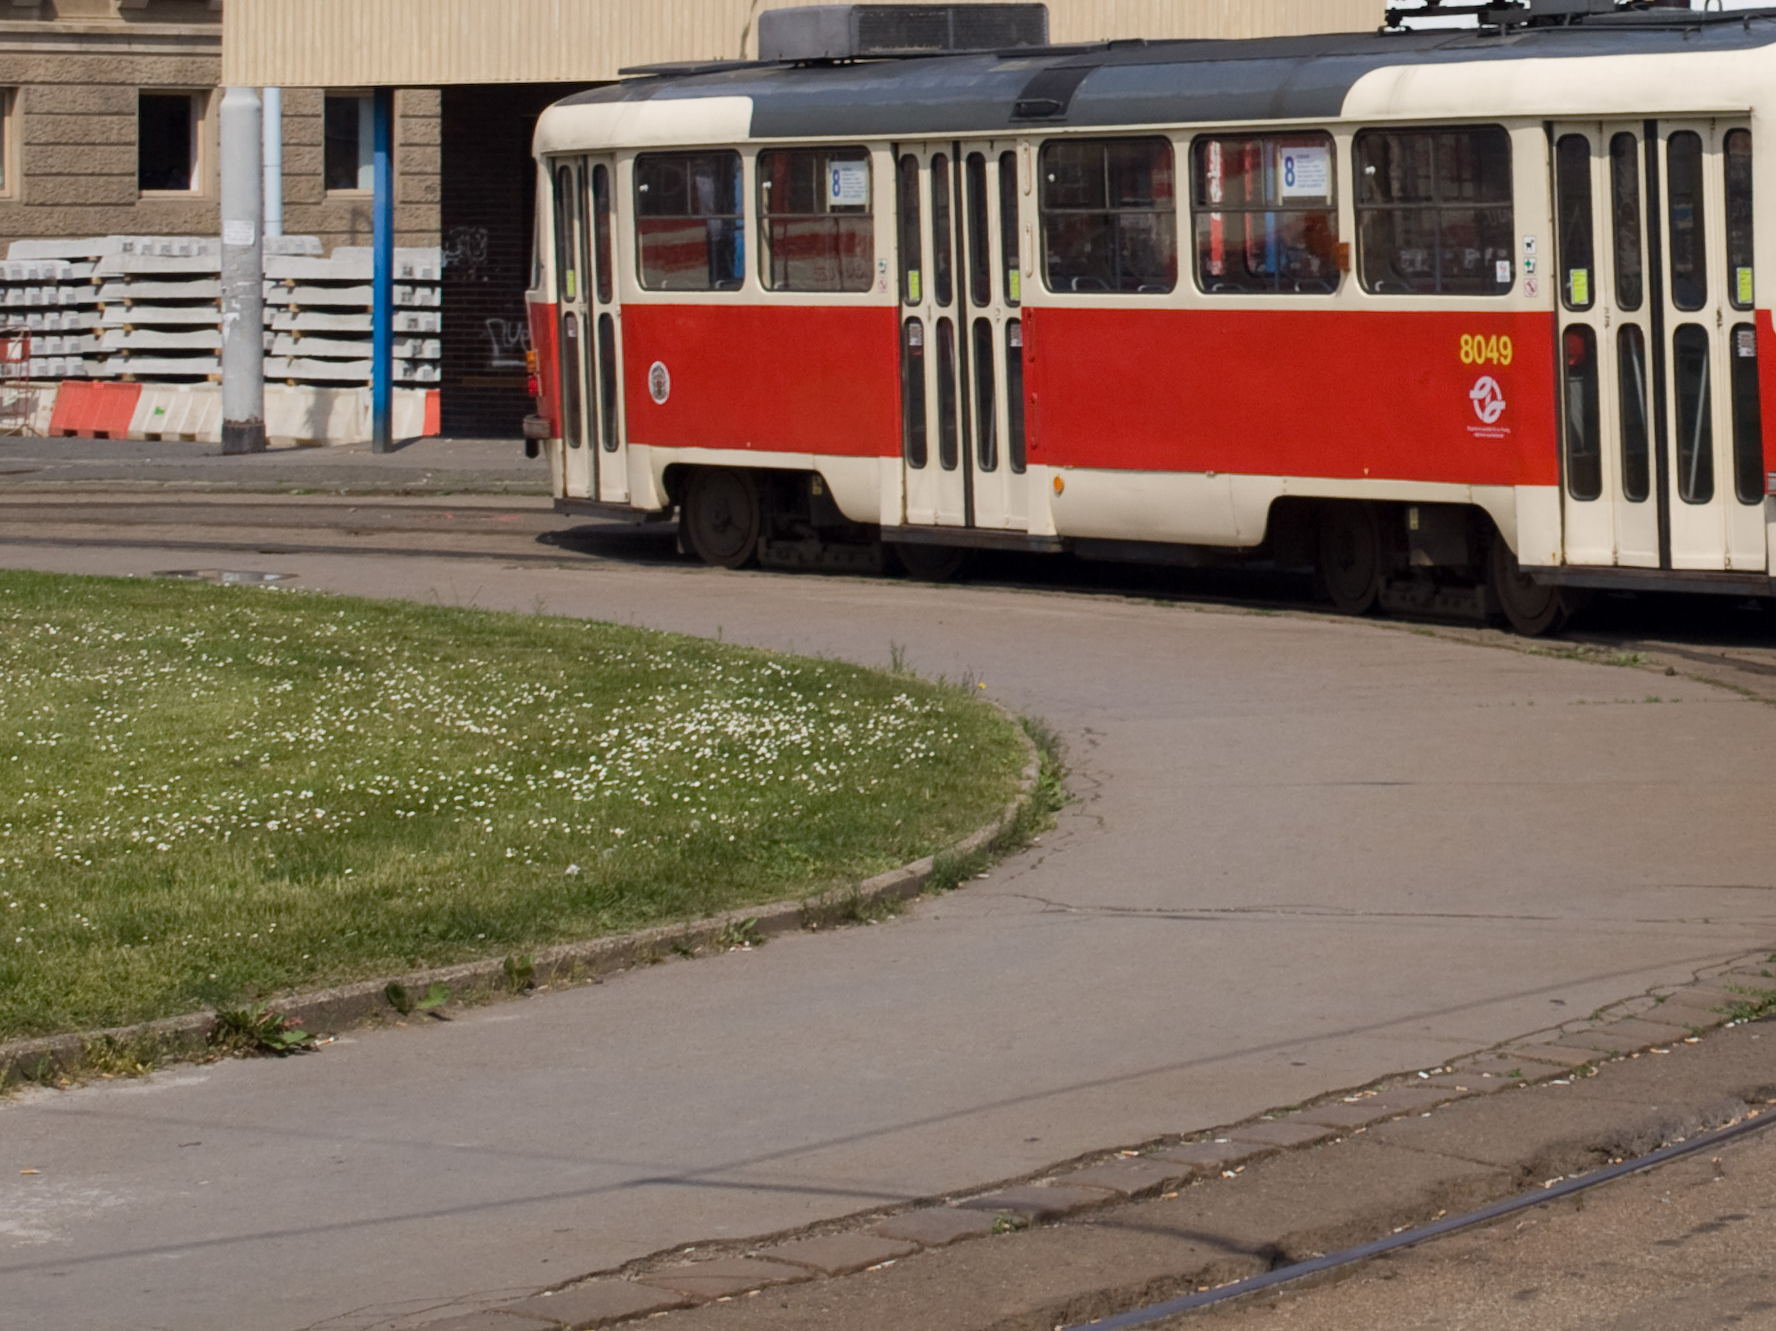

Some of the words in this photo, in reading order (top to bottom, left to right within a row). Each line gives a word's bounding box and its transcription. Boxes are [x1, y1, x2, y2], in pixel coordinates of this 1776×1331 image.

[832, 169, 841, 197] 8
[1284, 155, 1296, 188] 8
[1460, 333, 1513, 366] 8049
